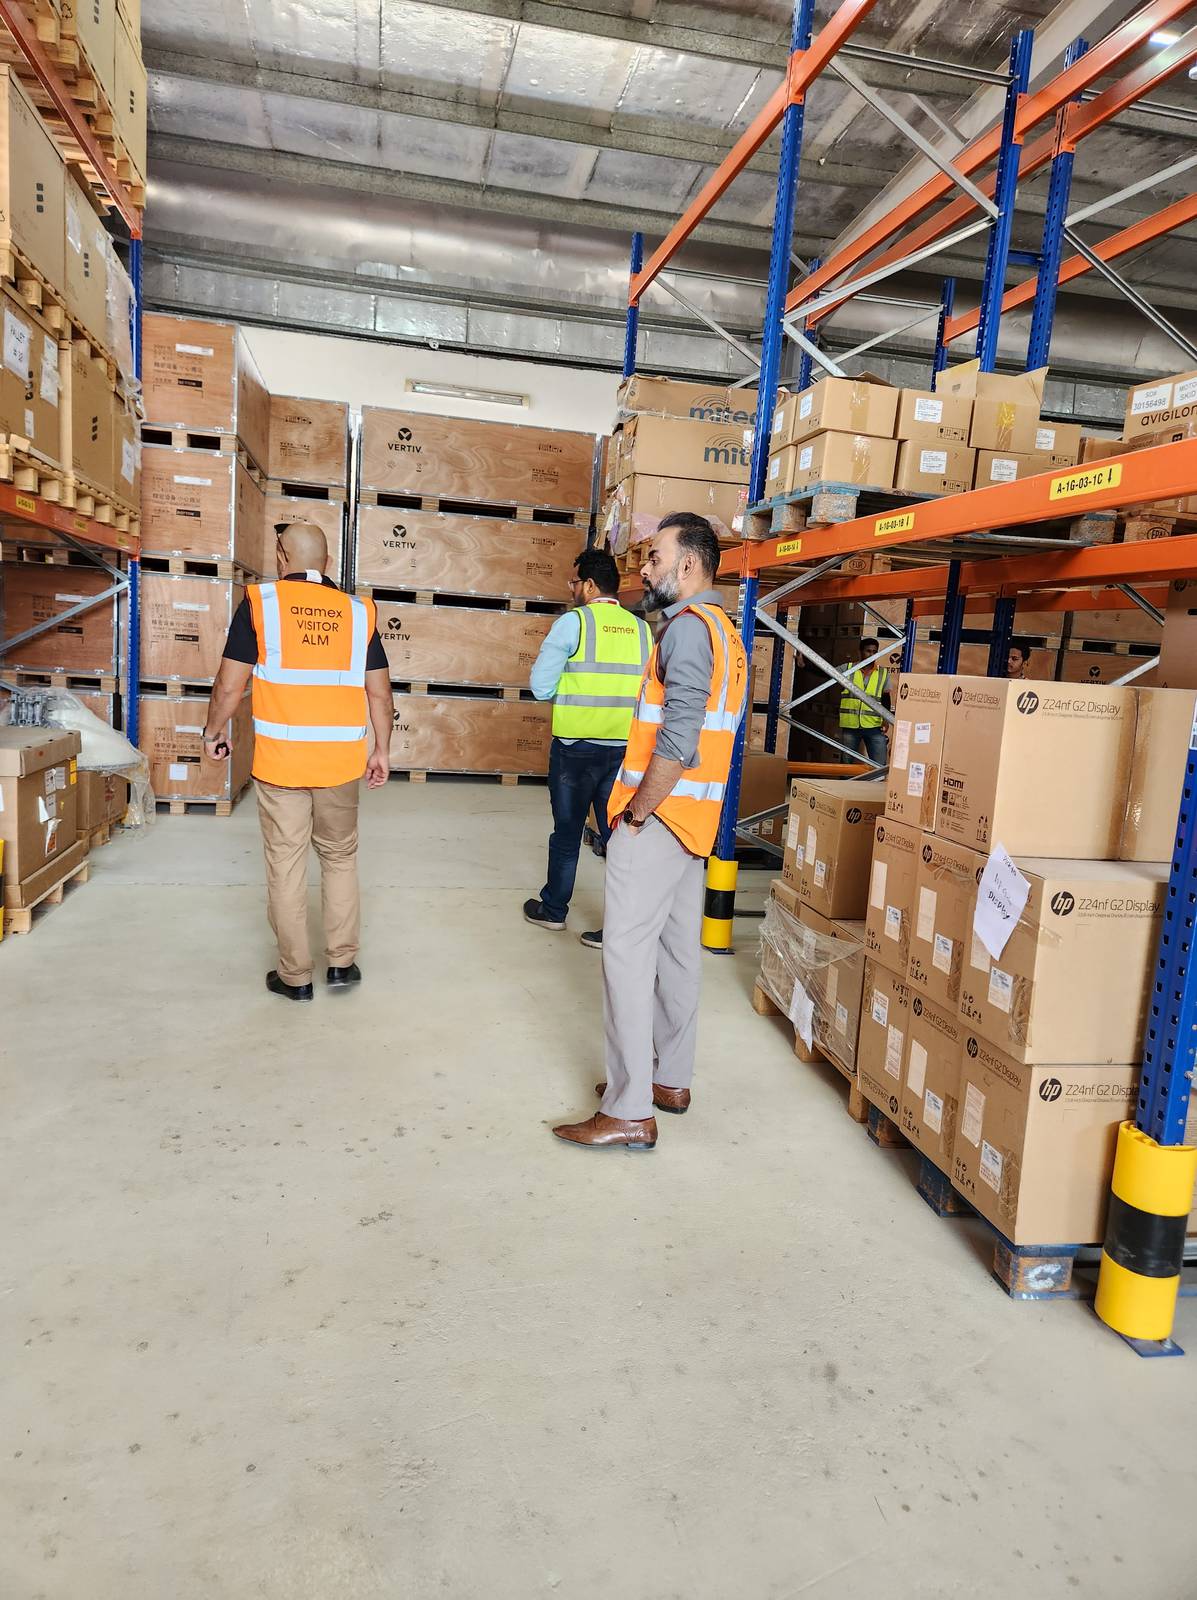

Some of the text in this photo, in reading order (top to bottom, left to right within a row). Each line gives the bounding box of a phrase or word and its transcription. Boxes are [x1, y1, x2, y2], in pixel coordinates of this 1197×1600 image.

[388, 443, 422, 453] VERTIV
[704, 446, 752, 467] mit
[1057, 472, 1103, 494] A-1G-03-1C
[383, 540, 416, 549] VERTIV
[290, 606, 343, 618] aramex
[297, 620, 338, 632] VISITOR
[602, 624, 635, 635] aramex
[302, 634, 329, 646] ALM
[1017, 691, 1039, 714] hp
[1043, 698, 1071, 710] Z24nf
[1072, 701, 1086, 712] G2
[1087, 702, 1121, 717] Display
[846, 807, 862, 824] hp
[1051, 891, 1160, 916] hp Z24nf G2 Display
[1039, 1078, 1139, 1102] hp Z24nf G2 Displa
